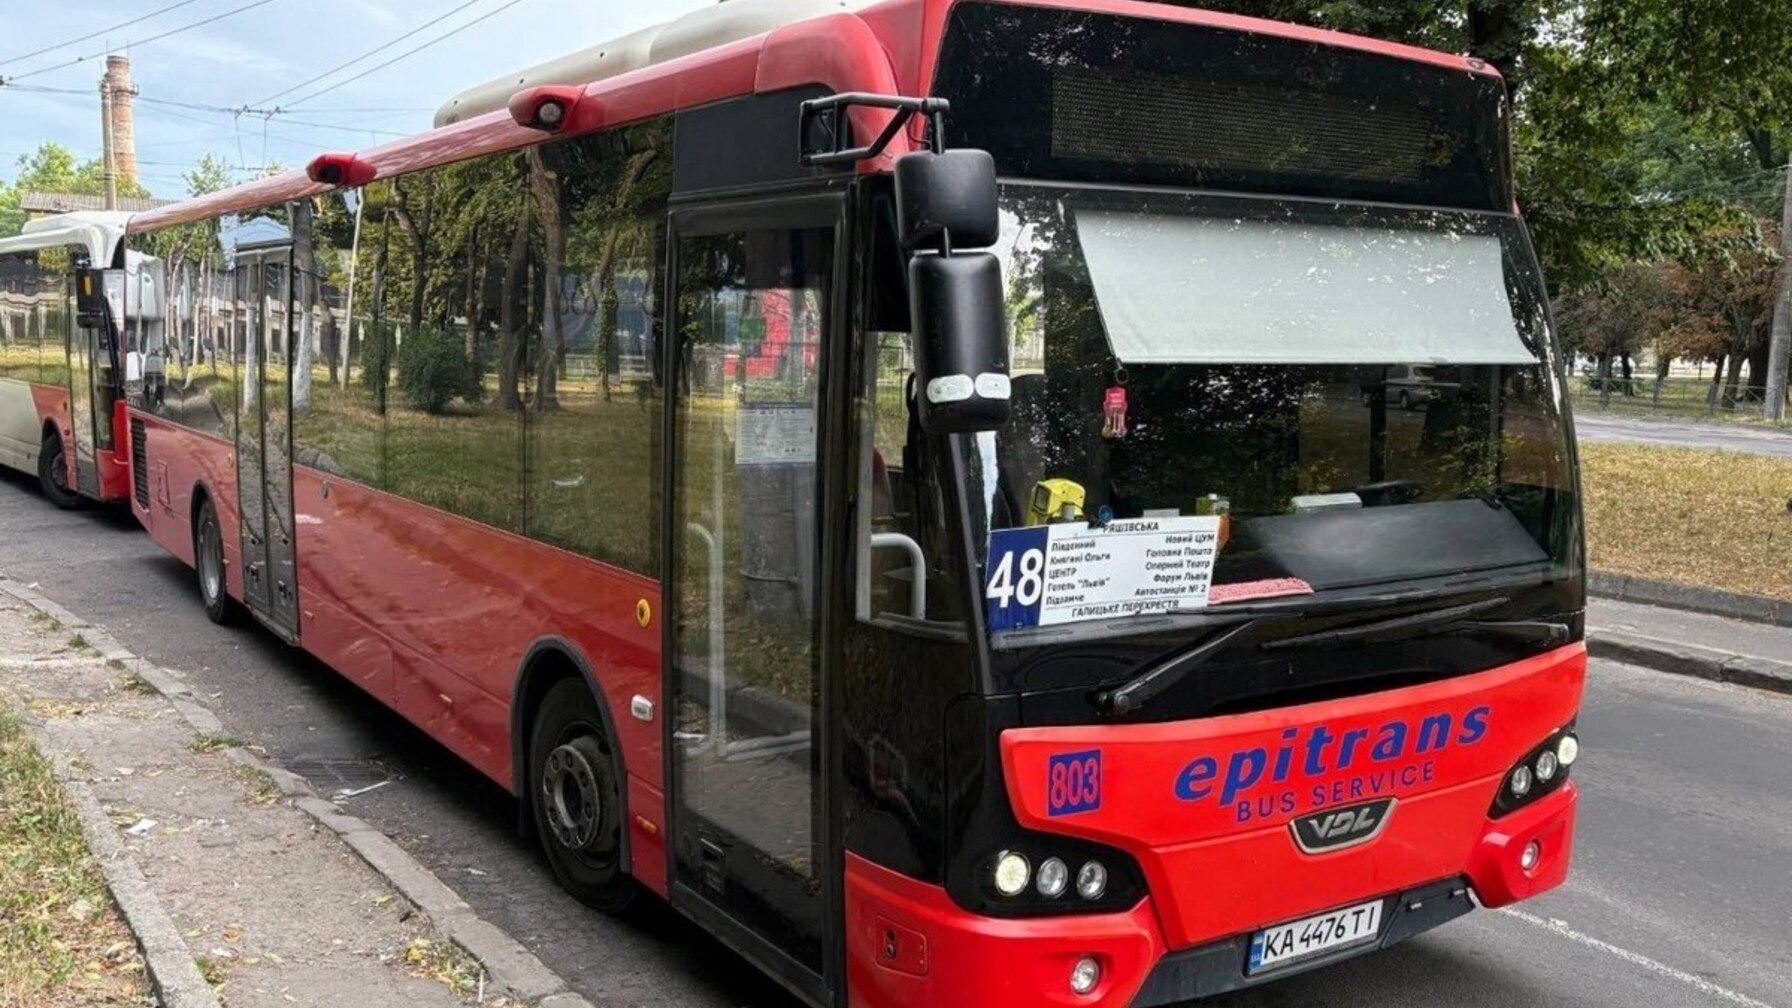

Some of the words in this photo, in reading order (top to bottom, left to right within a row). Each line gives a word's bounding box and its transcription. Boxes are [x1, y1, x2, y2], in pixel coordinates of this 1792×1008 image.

[1165, 534, 1193, 543] Новий
[1195, 533, 1215, 543] ЦУМ
[1051, 540, 1096, 551] Південний
[1084, 553, 1111, 563] Ольги
[1146, 549, 1182, 558] Головна
[1184, 546, 1213, 556] Пошта
[1145, 559, 1184, 571] Оперний
[1186, 560, 1211, 569] Театр
[986, 548, 1044, 608] 48
[1049, 567, 1077, 579] ЦЕНТР
[1153, 573, 1182, 584] Форум
[1183, 572, 1208, 581] Львів
[1048, 582, 1076, 592] Готель
[1134, 585, 1186, 597] Автостанція
[1200, 584, 1207, 593] 2
[1046, 594, 1085, 605] Підзамче
[1071, 603, 1120, 618] ГАЛИЦЬКЕ
[1121, 599, 1180, 613] ПЕРЕХРЕСТЯ
[1173, 705, 1491, 808] epitrans
[1050, 754, 1099, 810] 803
[1237, 792, 1296, 823] BUS
[1311, 761, 1435, 806] SERVICE
[1309, 806, 1378, 840] VDL
[1299, 913, 1347, 949] 4476
